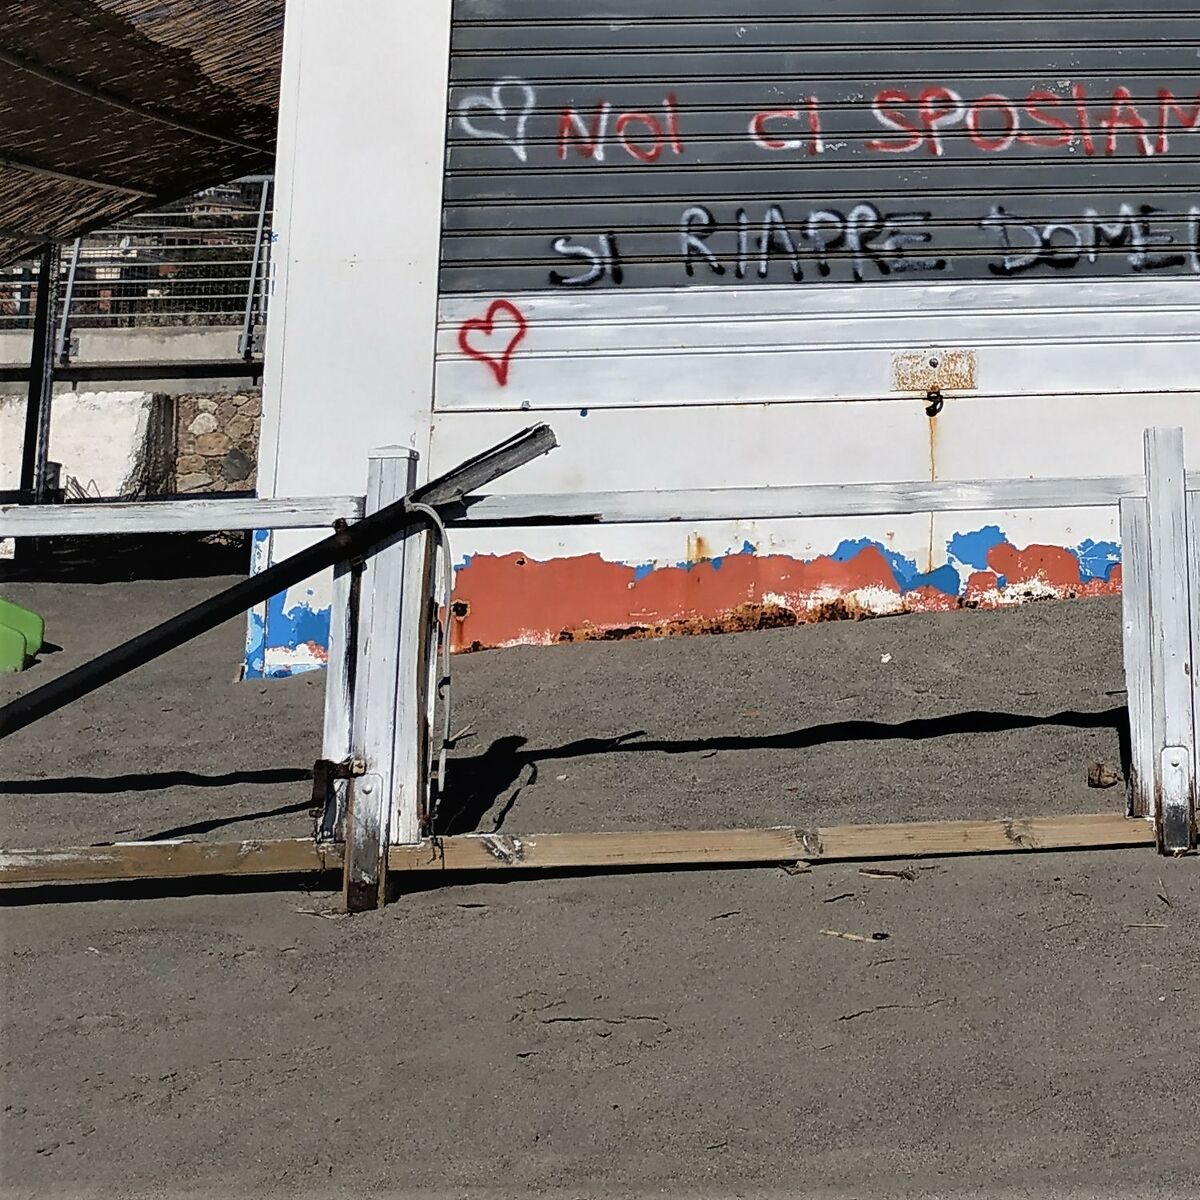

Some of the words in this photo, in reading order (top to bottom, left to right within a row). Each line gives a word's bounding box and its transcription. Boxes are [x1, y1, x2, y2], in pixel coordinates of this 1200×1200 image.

[556, 92, 684, 161] NOI
[748, 96, 824, 156] CI
[548, 230, 625, 286] SI
[680, 201, 948, 281] RIAPRE
